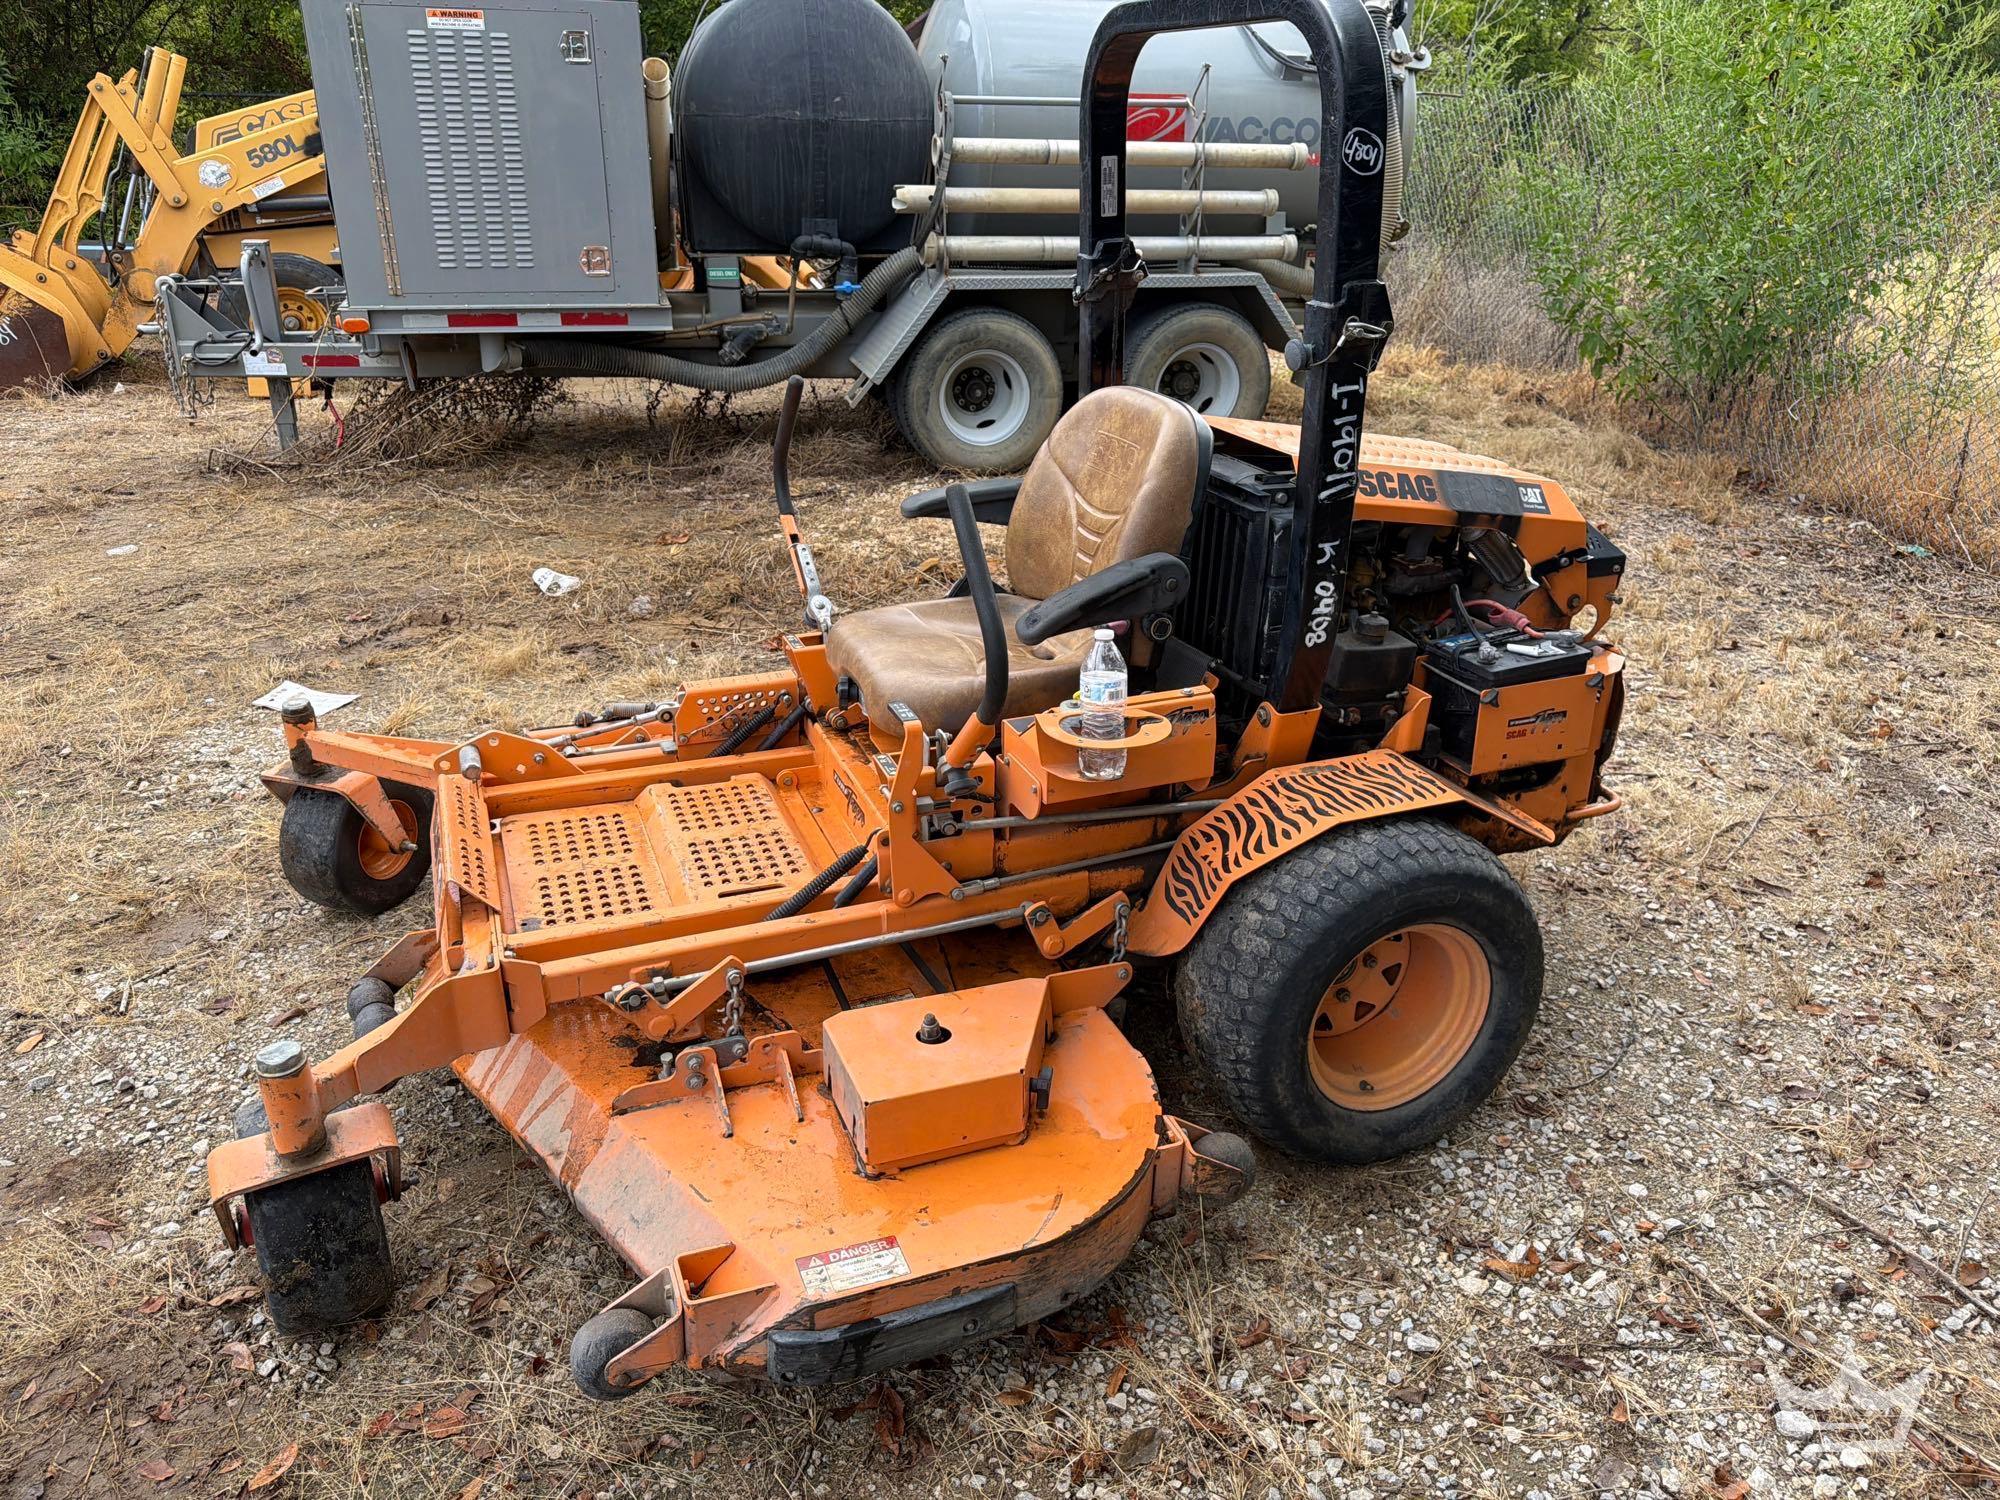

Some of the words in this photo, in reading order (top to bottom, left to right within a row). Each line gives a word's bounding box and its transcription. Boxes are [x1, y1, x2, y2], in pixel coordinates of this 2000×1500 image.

[440, 10, 479, 19] WARNING
[245, 134, 305, 169] 580L
[1358, 469, 1438, 503] SCAG
[1518, 486, 1543, 504] CAT
[1506, 729, 1527, 740] SCAG
[828, 1239, 890, 1263] DANGER
